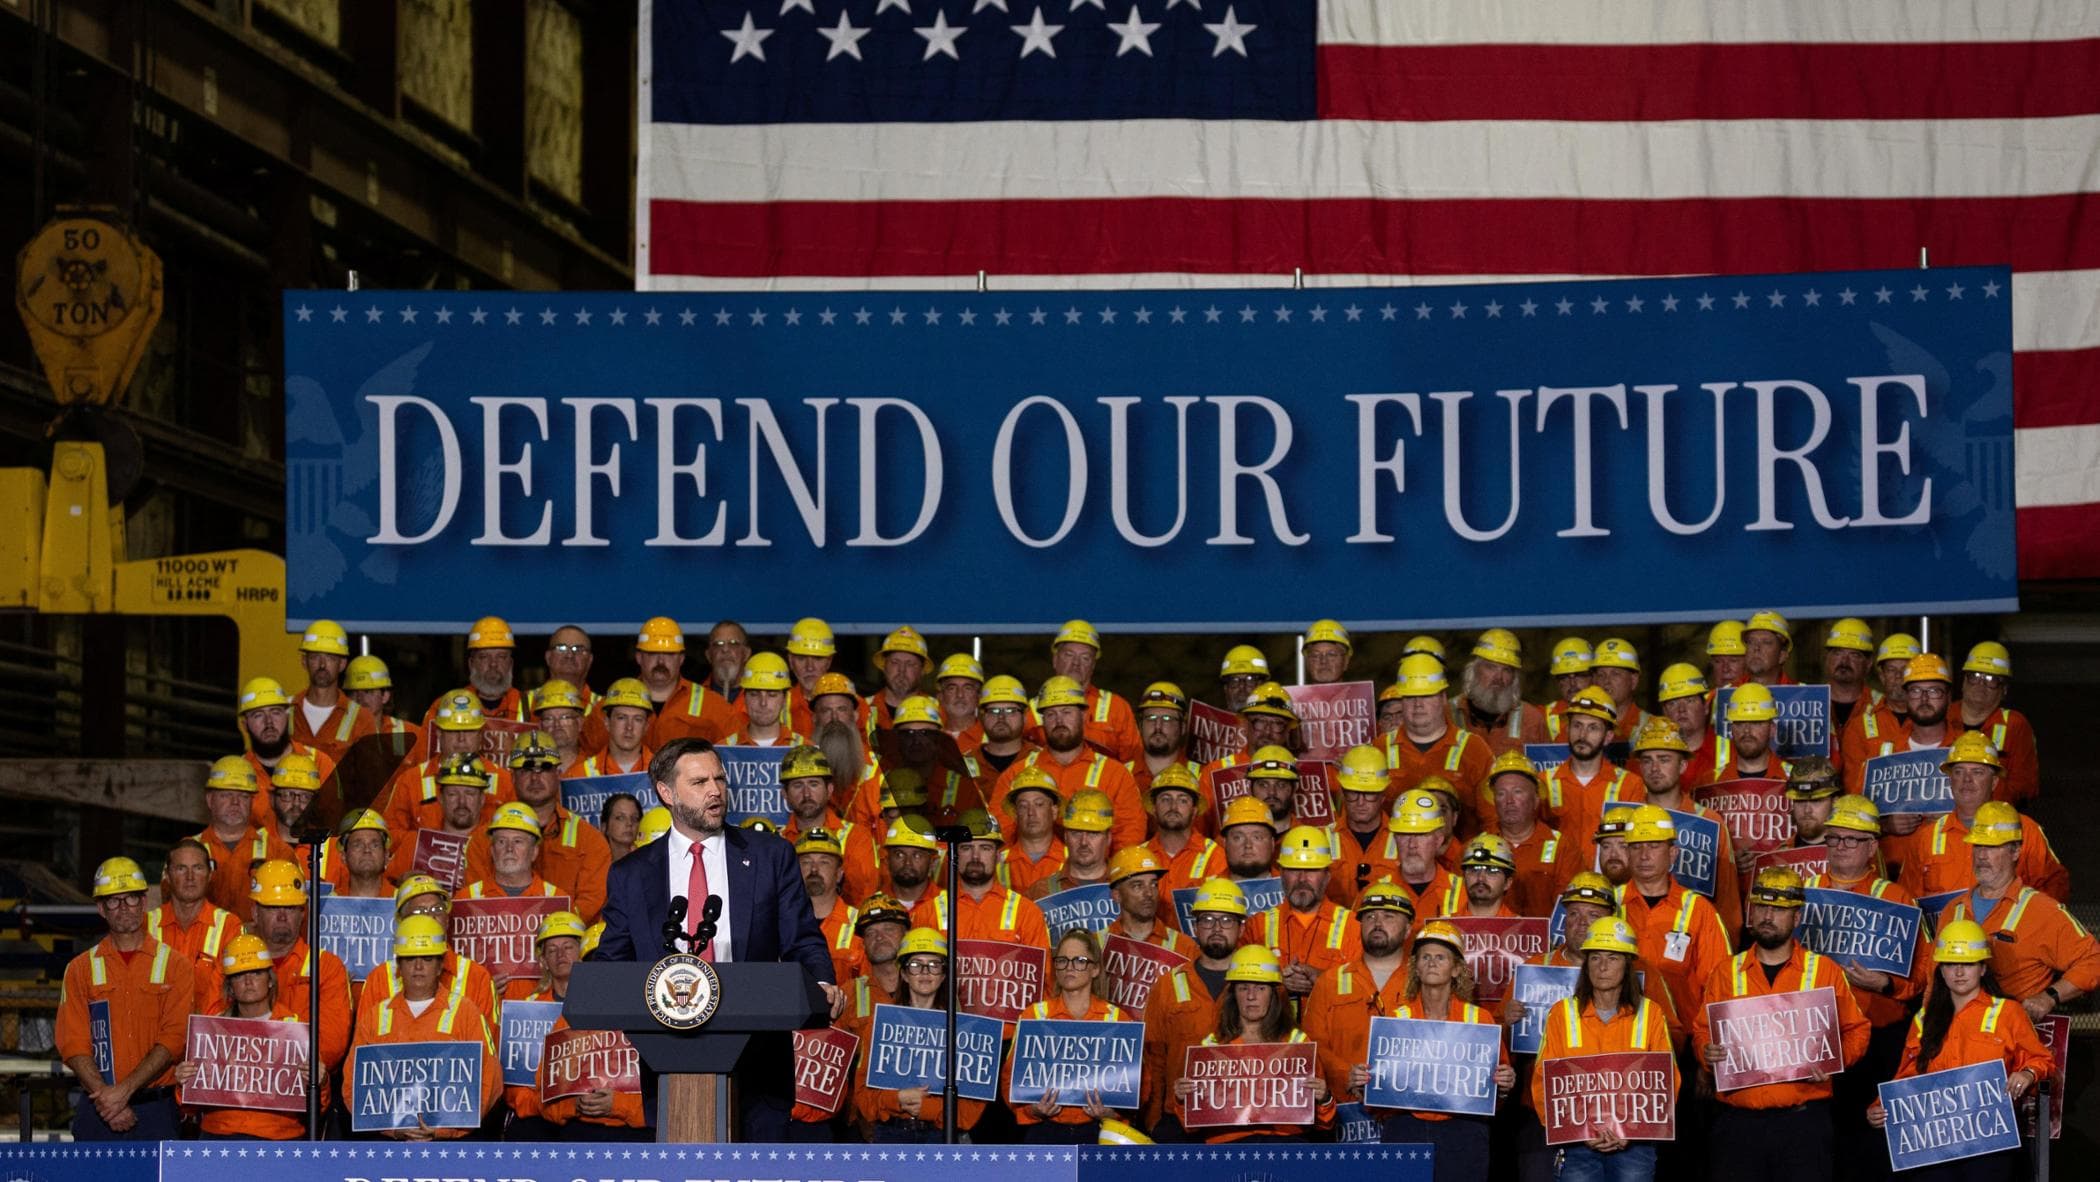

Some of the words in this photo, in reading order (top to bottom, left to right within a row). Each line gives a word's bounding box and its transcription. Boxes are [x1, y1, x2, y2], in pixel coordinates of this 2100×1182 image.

[63, 228, 100, 250] 50
[54, 302, 110, 325] TON
[365, 394, 944, 549] DEFEND
[992, 394, 1311, 549] OUR
[1344, 373, 1933, 545] FUTURE
[212, 559, 239, 574] WT
[1334, 698, 1370, 718] OUR
[1789, 701, 1825, 717] OUR
[1195, 715, 1248, 747] INVES
[1301, 718, 1371, 749] TURE
[721, 761, 782, 785] NVEST
[1872, 761, 1935, 783] DEFEND
[635, 788, 659, 807] OU
[727, 787, 794, 813] MERI
[1220, 778, 1252, 799] DEF
[1298, 775, 1324, 791] UR
[1870, 776, 1954, 803] FUTUR
[1766, 794, 1792, 812] OU
[1678, 829, 1712, 853] OUR
[319, 914, 385, 935] DEFEND
[453, 914, 522, 935] DEFEND
[1045, 900, 1093, 926] FEND
[1096, 898, 1121, 915] OU
[1801, 902, 1883, 932] INVEST
[1886, 915, 1912, 940] IN
[452, 934, 538, 965] FUTU
[1463, 933, 1501, 952] END
[1505, 933, 1543, 953] OUR
[1800, 927, 1905, 964] AMERICA
[647, 962, 667, 1006] PRESIDENT
[696, 960, 719, 992] UNITED
[957, 956, 997, 976] END
[1000, 960, 1038, 983] OUR
[958, 977, 1037, 1010] TURE
[655, 1007, 671, 1025] VICE
[695, 995, 718, 1024] STATES
[1717, 1009, 1800, 1046] INVEST
[1804, 1005, 1830, 1033] IN
[193, 1032, 279, 1064] INVEST
[283, 1038, 309, 1065] IN
[550, 1030, 617, 1062] DEFEND
[807, 1038, 846, 1068] OUR
[955, 1030, 994, 1054] OUR
[1022, 1034, 1106, 1062] INVEST
[1109, 1038, 1137, 1064] IN
[1376, 1035, 1448, 1061] DEFEND
[1452, 1041, 1492, 1064] OUR
[1723, 1034, 1837, 1076] AMERICA
[191, 1062, 307, 1097] AMERICA
[360, 1058, 444, 1086] INVEST
[448, 1057, 476, 1083] IN
[547, 1047, 641, 1088] FUTUR
[1018, 1061, 1133, 1094] AMERICA
[1193, 1057, 1265, 1078] DEFEND
[1268, 1057, 1308, 1076] OUR
[1372, 1058, 1491, 1098] FUTURE
[1191, 1077, 1309, 1112] FUTURE
[1551, 1071, 1623, 1097] DEFEND
[1627, 1070, 1668, 1092] OUR
[360, 1085, 474, 1117] AMERICA
[1551, 1093, 1669, 1130] FUTURE
[1888, 1083, 1970, 1125] INVEST
[1975, 1078, 2004, 1107] IN
[1897, 1108, 2012, 1155] AMERICA
